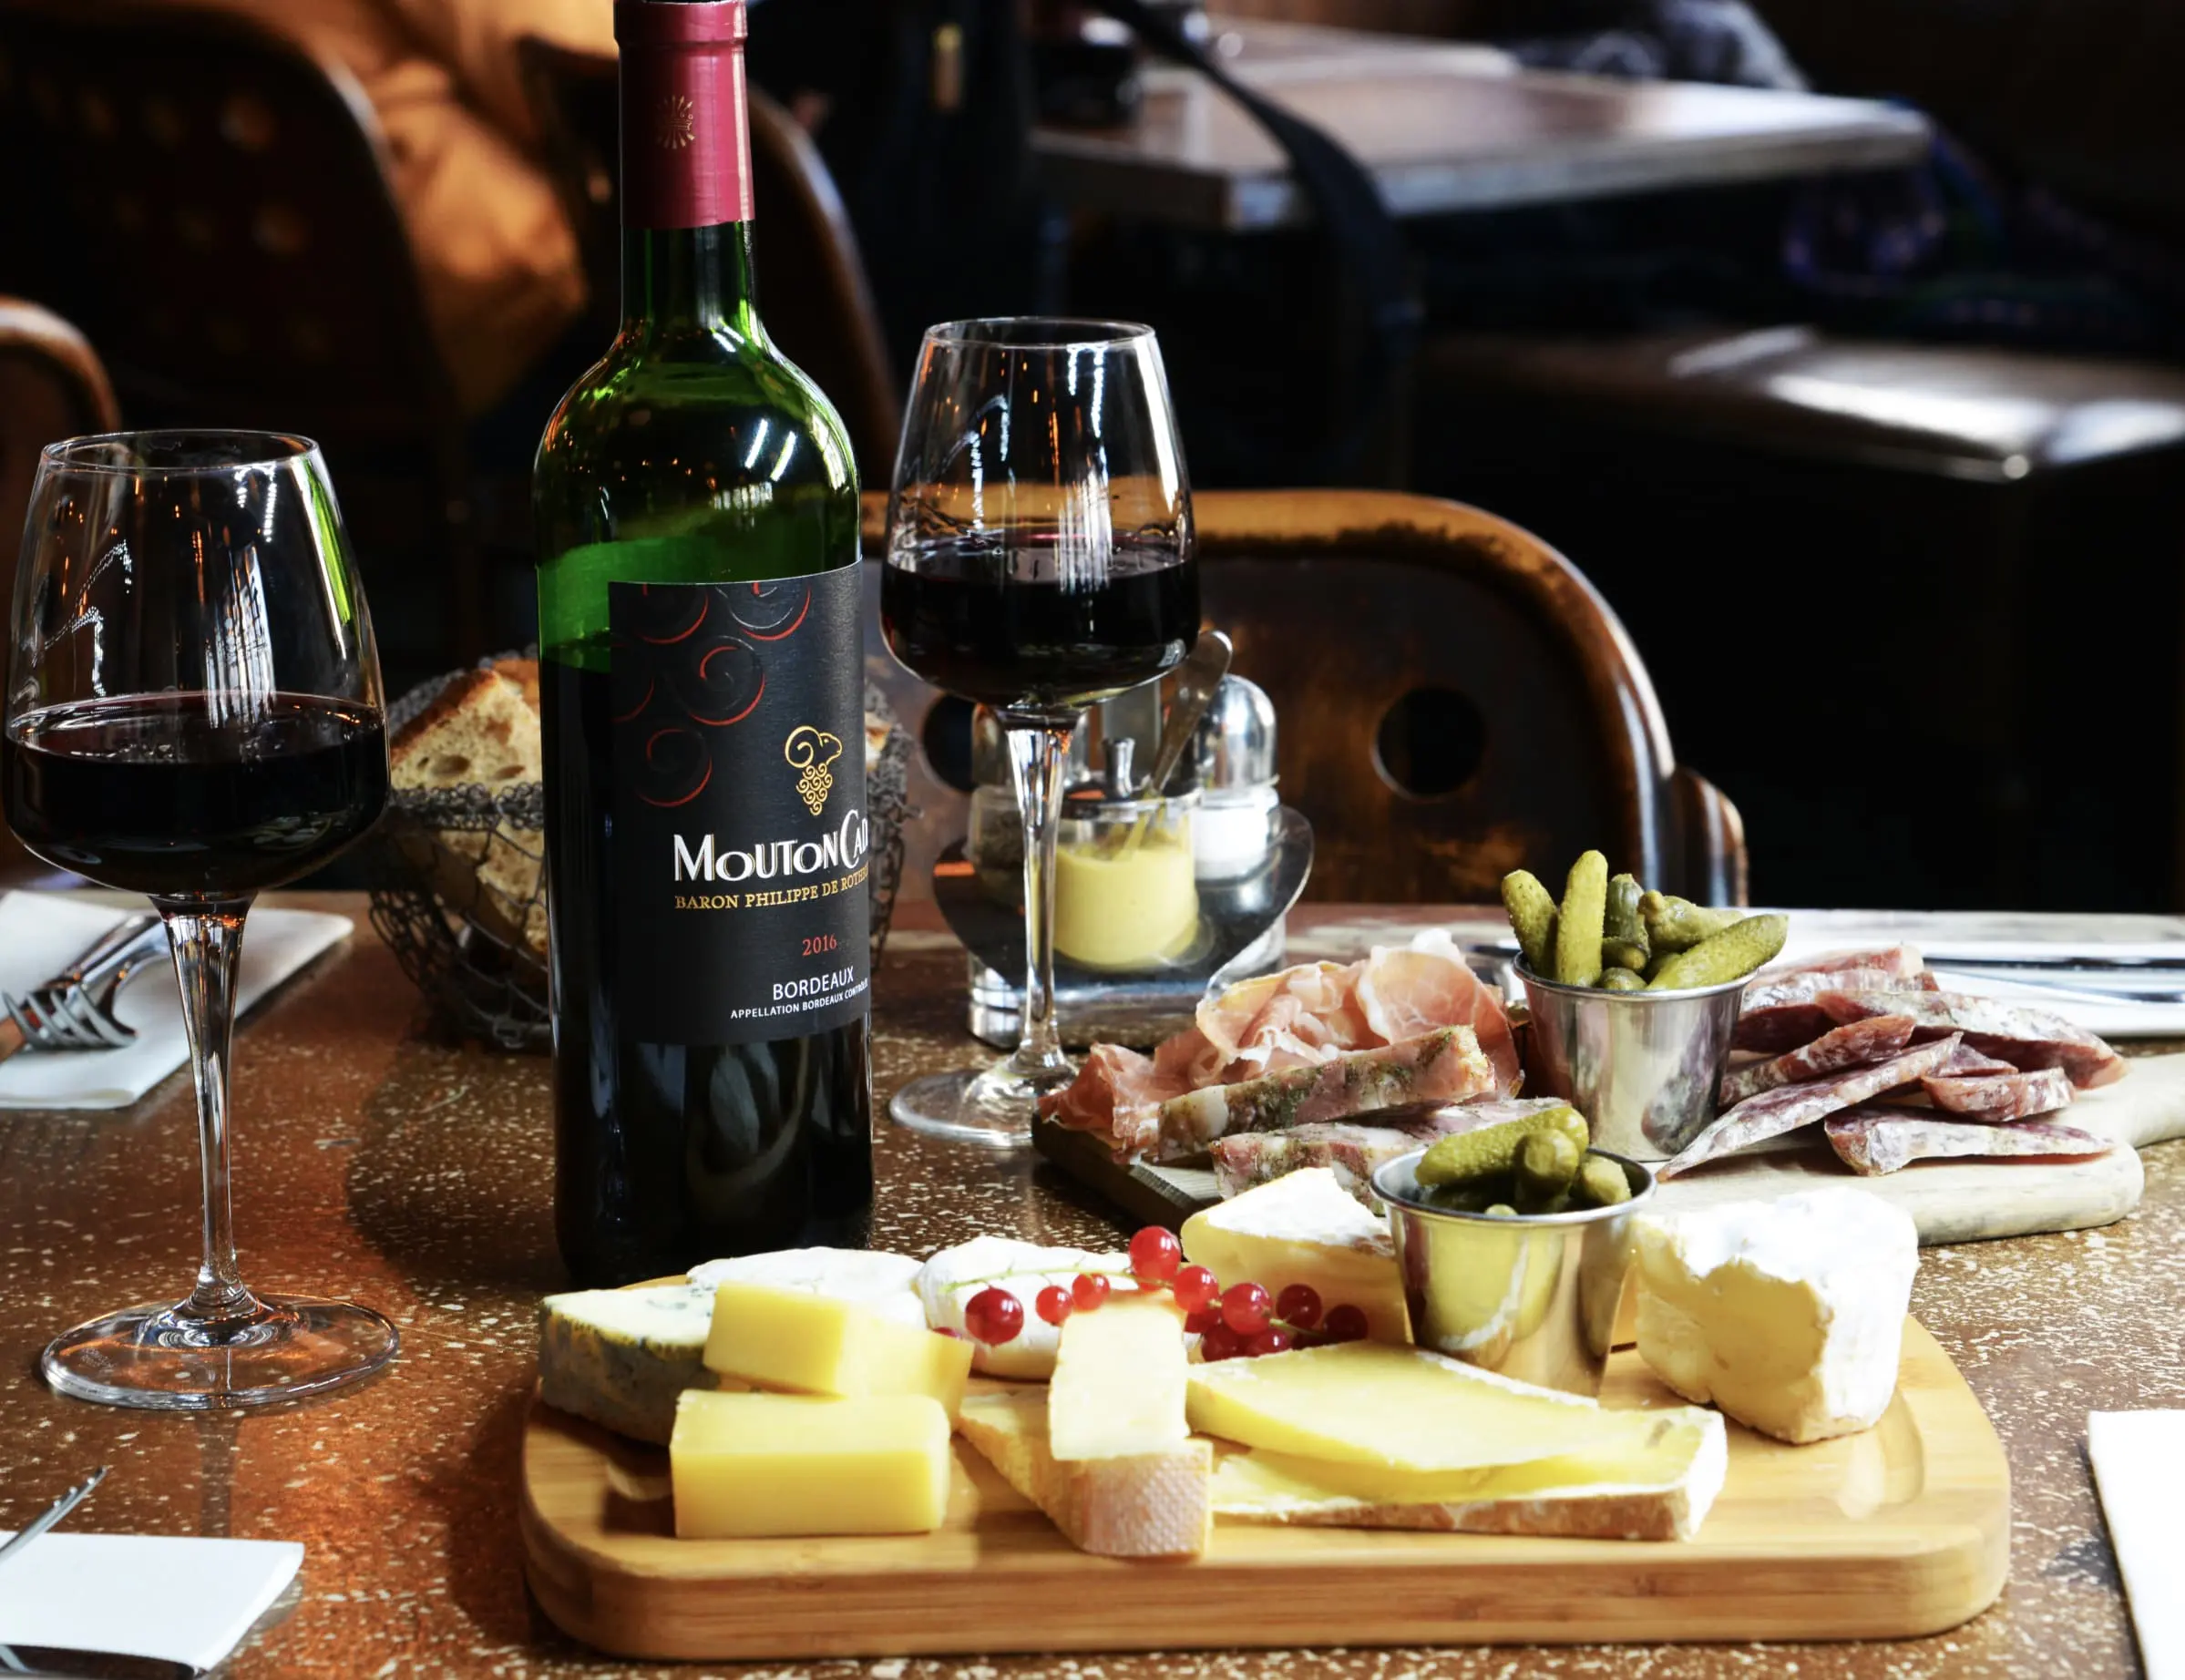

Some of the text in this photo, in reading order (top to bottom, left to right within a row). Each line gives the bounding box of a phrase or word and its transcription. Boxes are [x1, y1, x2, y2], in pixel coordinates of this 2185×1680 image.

[673, 830, 838, 882] MOUTON
[674, 894, 740, 909] BARON
[744, 885, 818, 907] PHILIPPE
[822, 883, 839, 897] DE
[802, 933, 837, 957] 2016
[773, 966, 854, 1001] BORDEAUX
[730, 1002, 800, 1019] APPELLATION
[802, 994, 844, 1011] BORDEAUX
